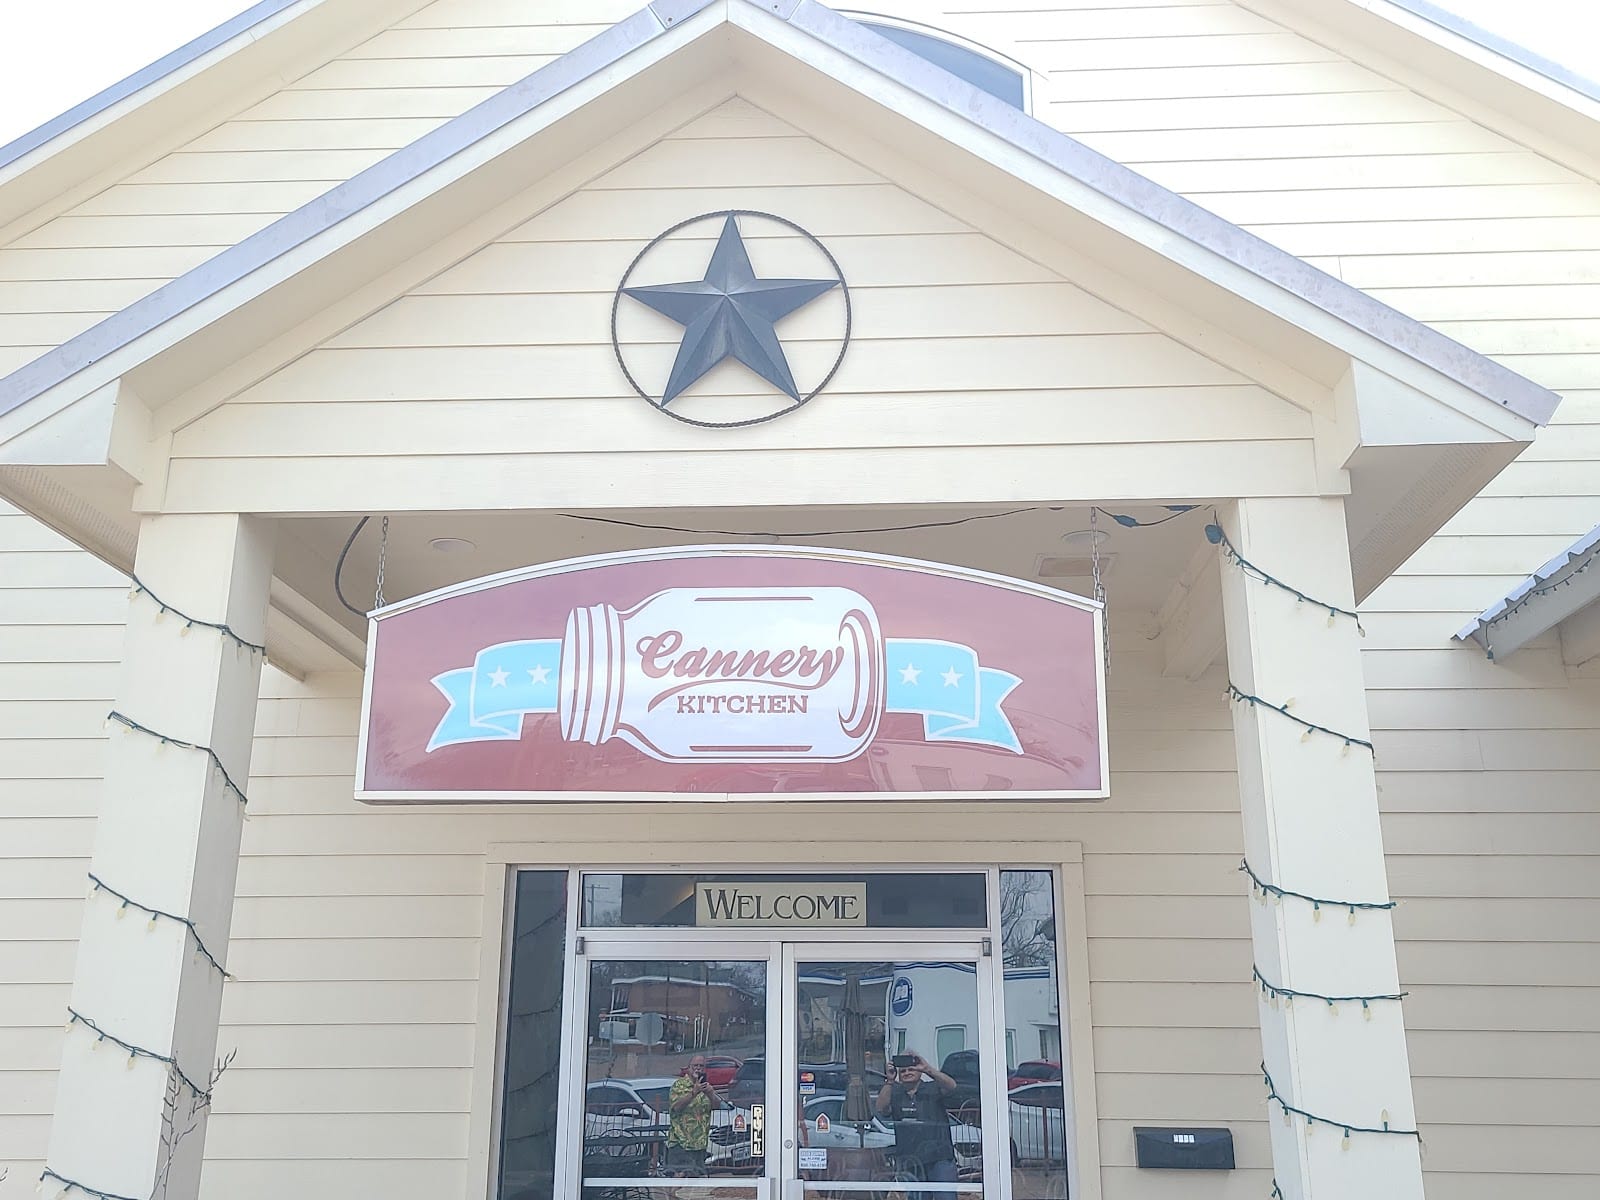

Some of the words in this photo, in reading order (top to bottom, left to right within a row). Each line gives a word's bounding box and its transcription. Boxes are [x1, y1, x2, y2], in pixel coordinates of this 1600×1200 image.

[636, 630, 845, 690] Cannery
[677, 695, 809, 714] KITCHEN
[703, 888, 860, 920] WELCOME
[753, 1106, 762, 1154] PULL
